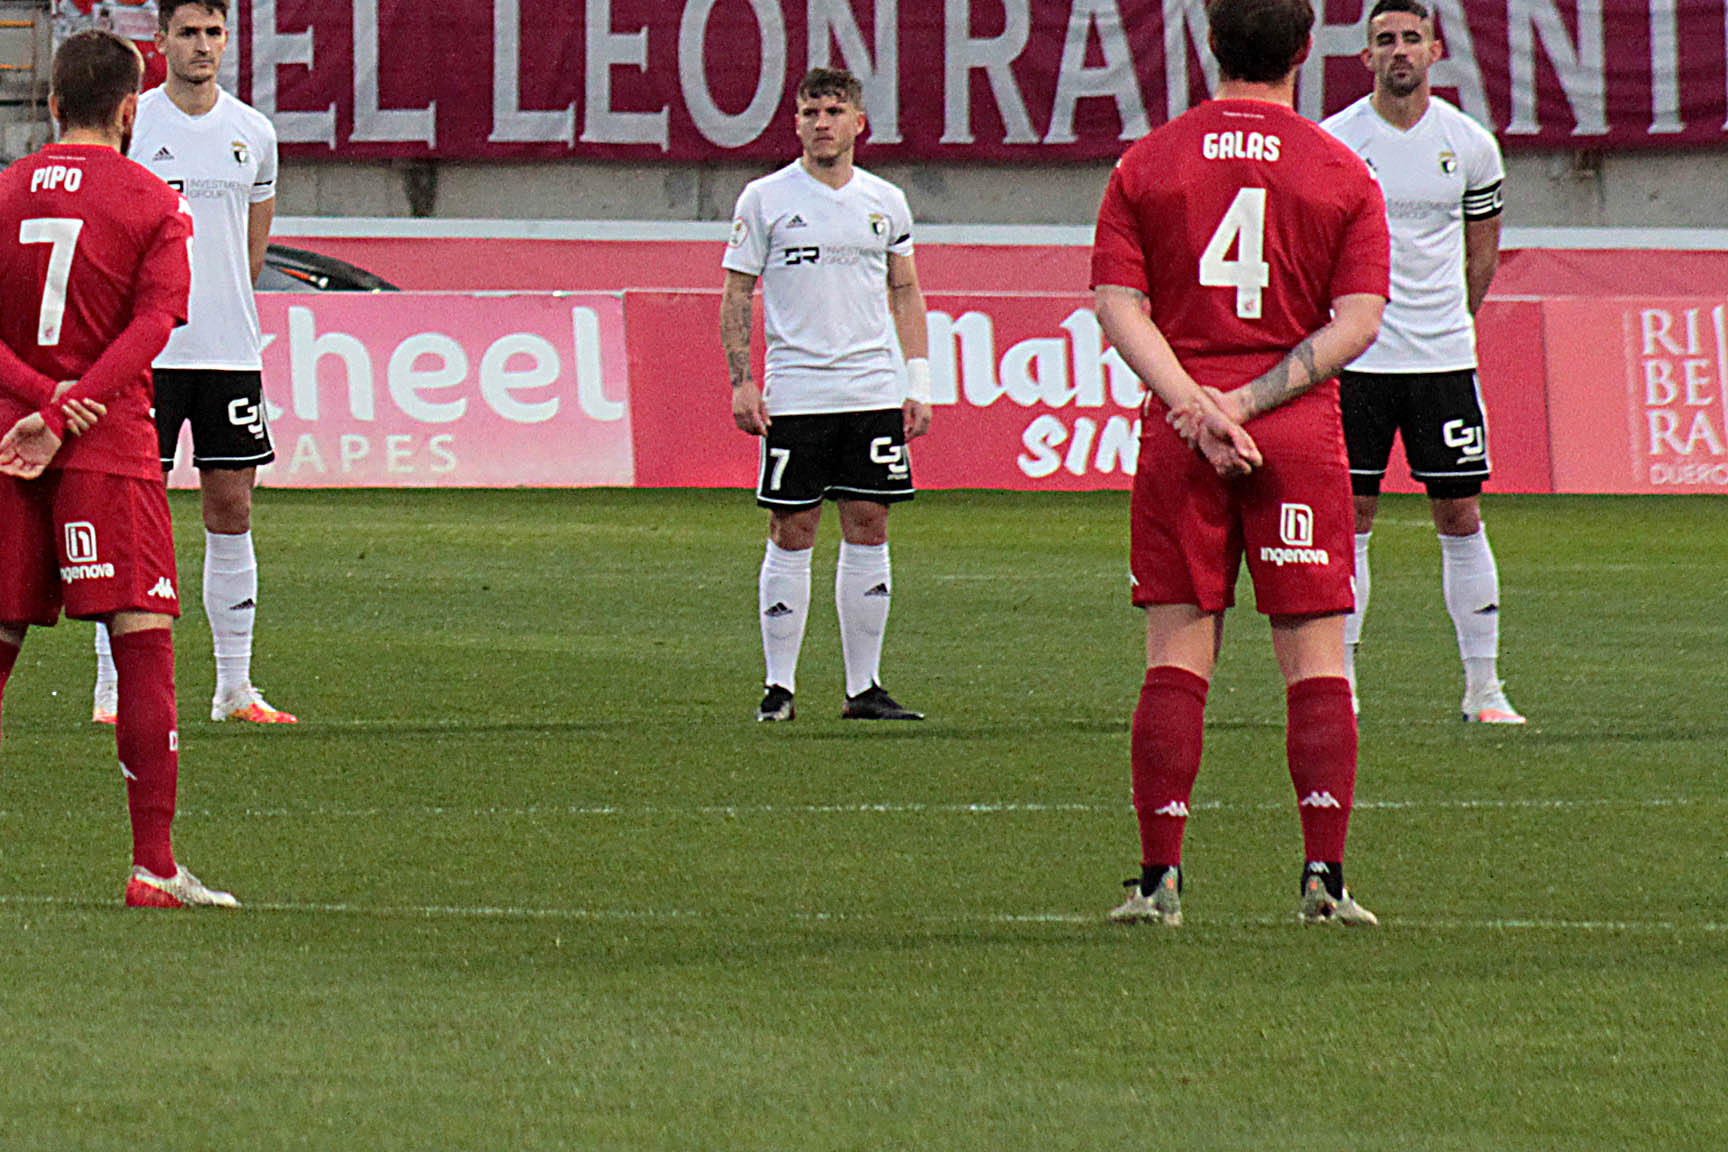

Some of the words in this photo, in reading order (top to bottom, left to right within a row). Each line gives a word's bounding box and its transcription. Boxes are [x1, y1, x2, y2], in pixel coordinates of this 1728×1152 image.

[1203, 131, 1281, 162] GALAS
[31, 166, 83, 192] PIPO
[1199, 187, 1269, 318] 4
[19, 218, 84, 346] 7
[260, 306, 625, 423] heel
[289, 433, 458, 473] APES
[770, 448, 791, 491] 7
[1017, 414, 1142, 478] SIN
